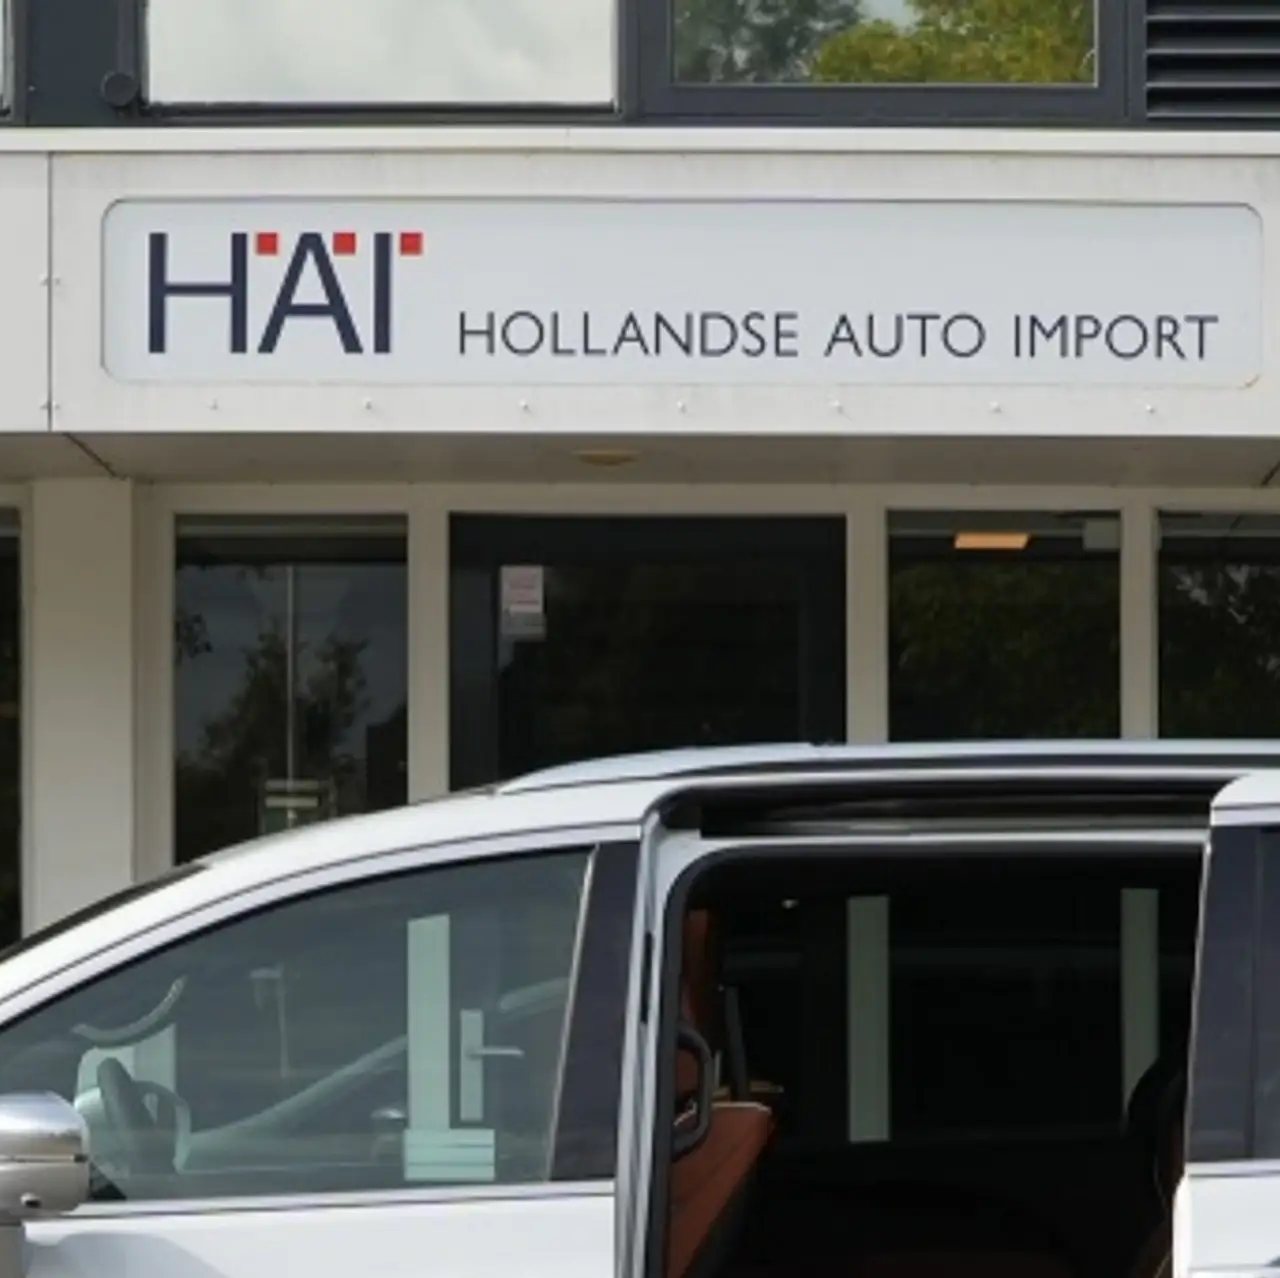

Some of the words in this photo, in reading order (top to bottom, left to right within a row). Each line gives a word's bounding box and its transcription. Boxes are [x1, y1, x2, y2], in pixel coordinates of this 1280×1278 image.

[459, 310, 798, 357] HOLLANDSE
[824, 313, 986, 358] AUTO
[1014, 314, 1219, 359] IMPORT
